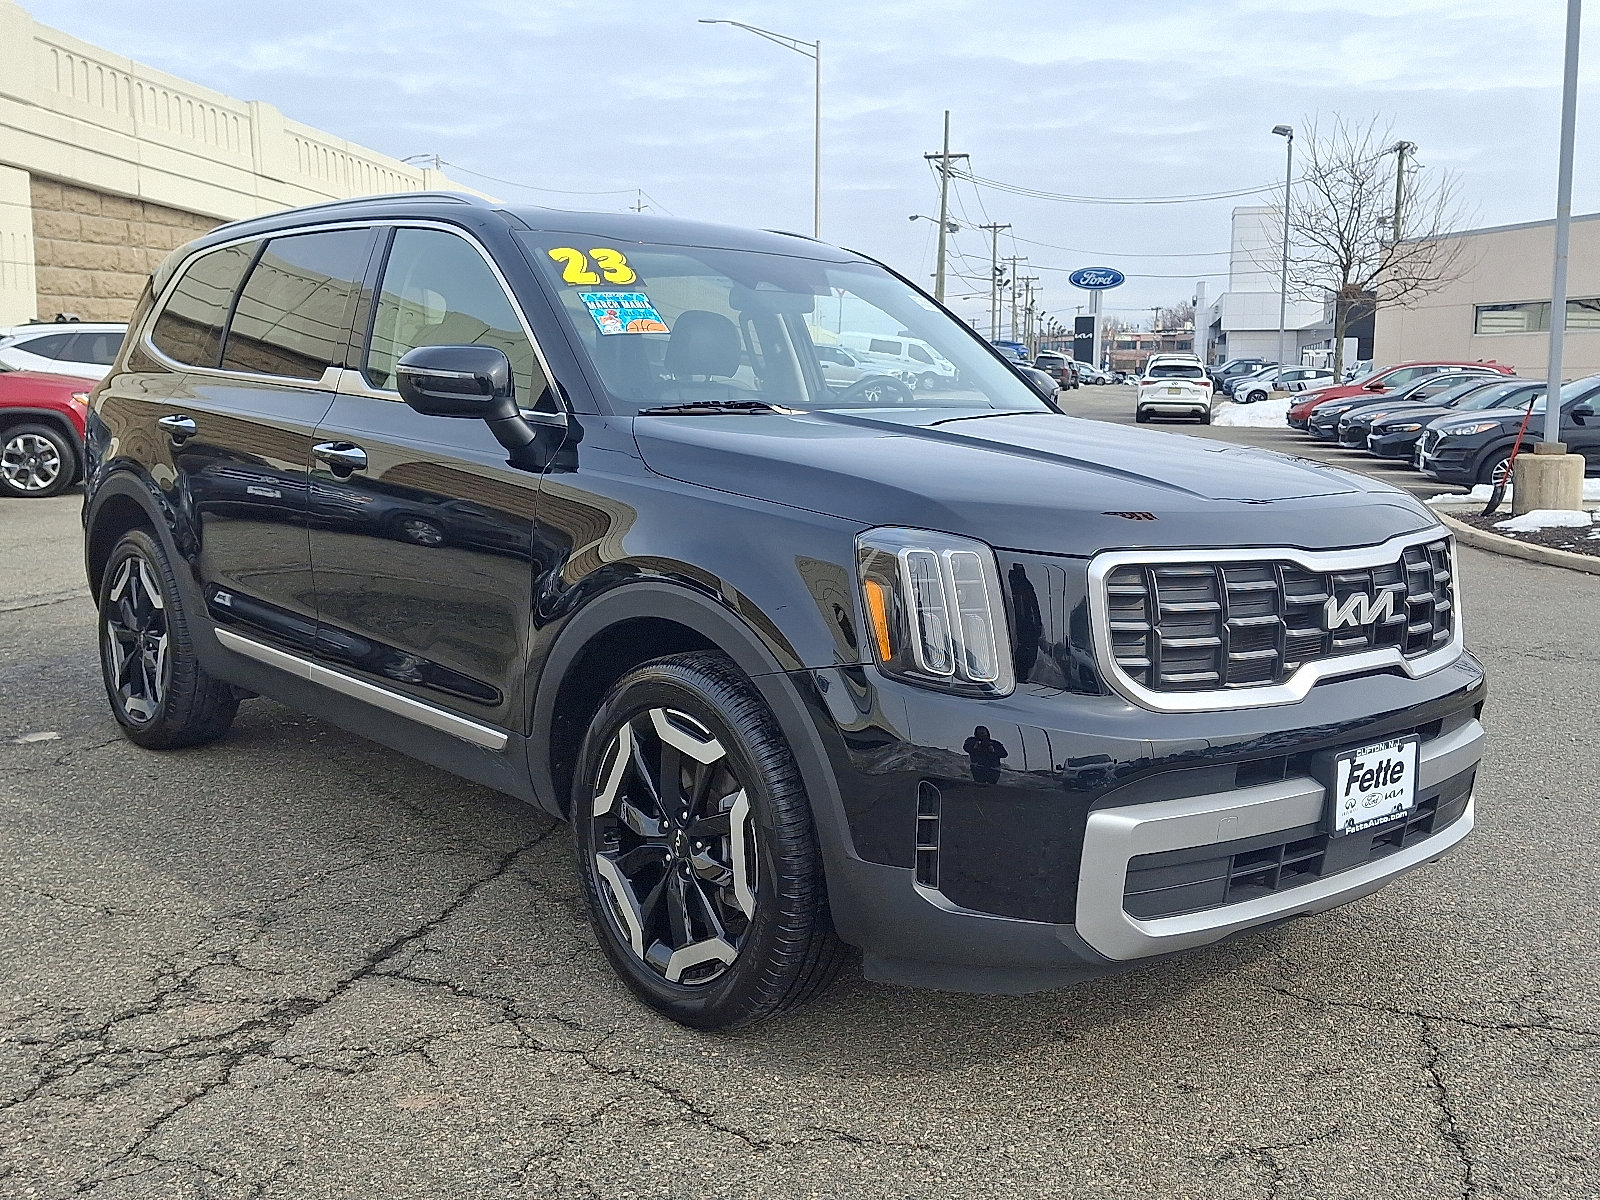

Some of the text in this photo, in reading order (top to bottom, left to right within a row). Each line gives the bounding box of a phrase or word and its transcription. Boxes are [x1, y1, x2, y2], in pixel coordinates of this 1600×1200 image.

[548, 247, 637, 285] 23
[1080, 270, 1114, 285] Ford
[586, 300, 652, 309] MARCH MANIA
[1324, 589, 1393, 629] KIA
[1344, 758, 1405, 797] Fette
